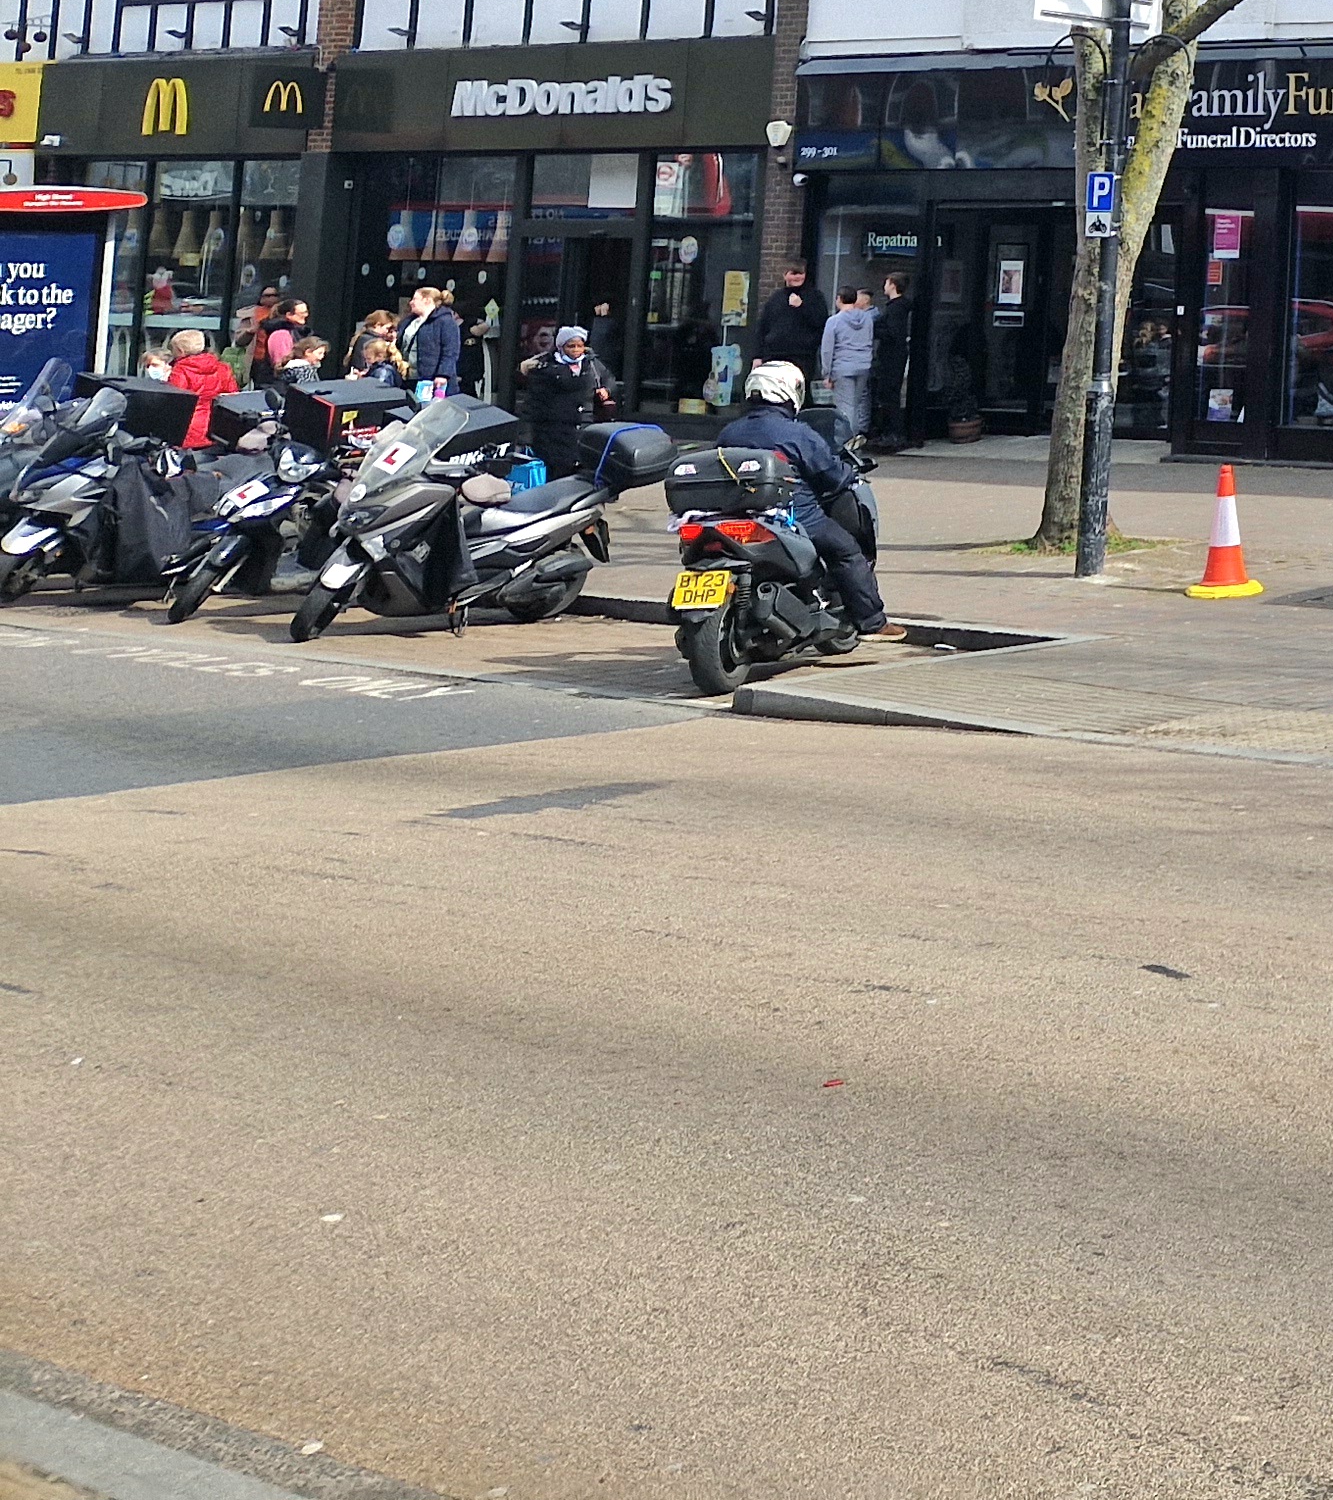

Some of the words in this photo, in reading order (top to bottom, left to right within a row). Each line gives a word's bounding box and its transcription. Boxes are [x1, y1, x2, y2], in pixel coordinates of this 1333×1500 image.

[450, 74, 672, 117] McDonald's
[1188, 71, 1286, 130] amily
[1176, 126, 1238, 149] Funeral
[1239, 126, 1317, 148] Directors
[1092, 176, 1111, 207] P
[6, 263, 46, 283] you
[17, 286, 39, 305] to
[41, 283, 73, 305] the
[383, 447, 399, 465] L
[236, 485, 253, 500] L
[680, 573, 725, 588] BT23
[682, 589, 717, 604] DHP
[299, 676, 476, 701] ONLY
